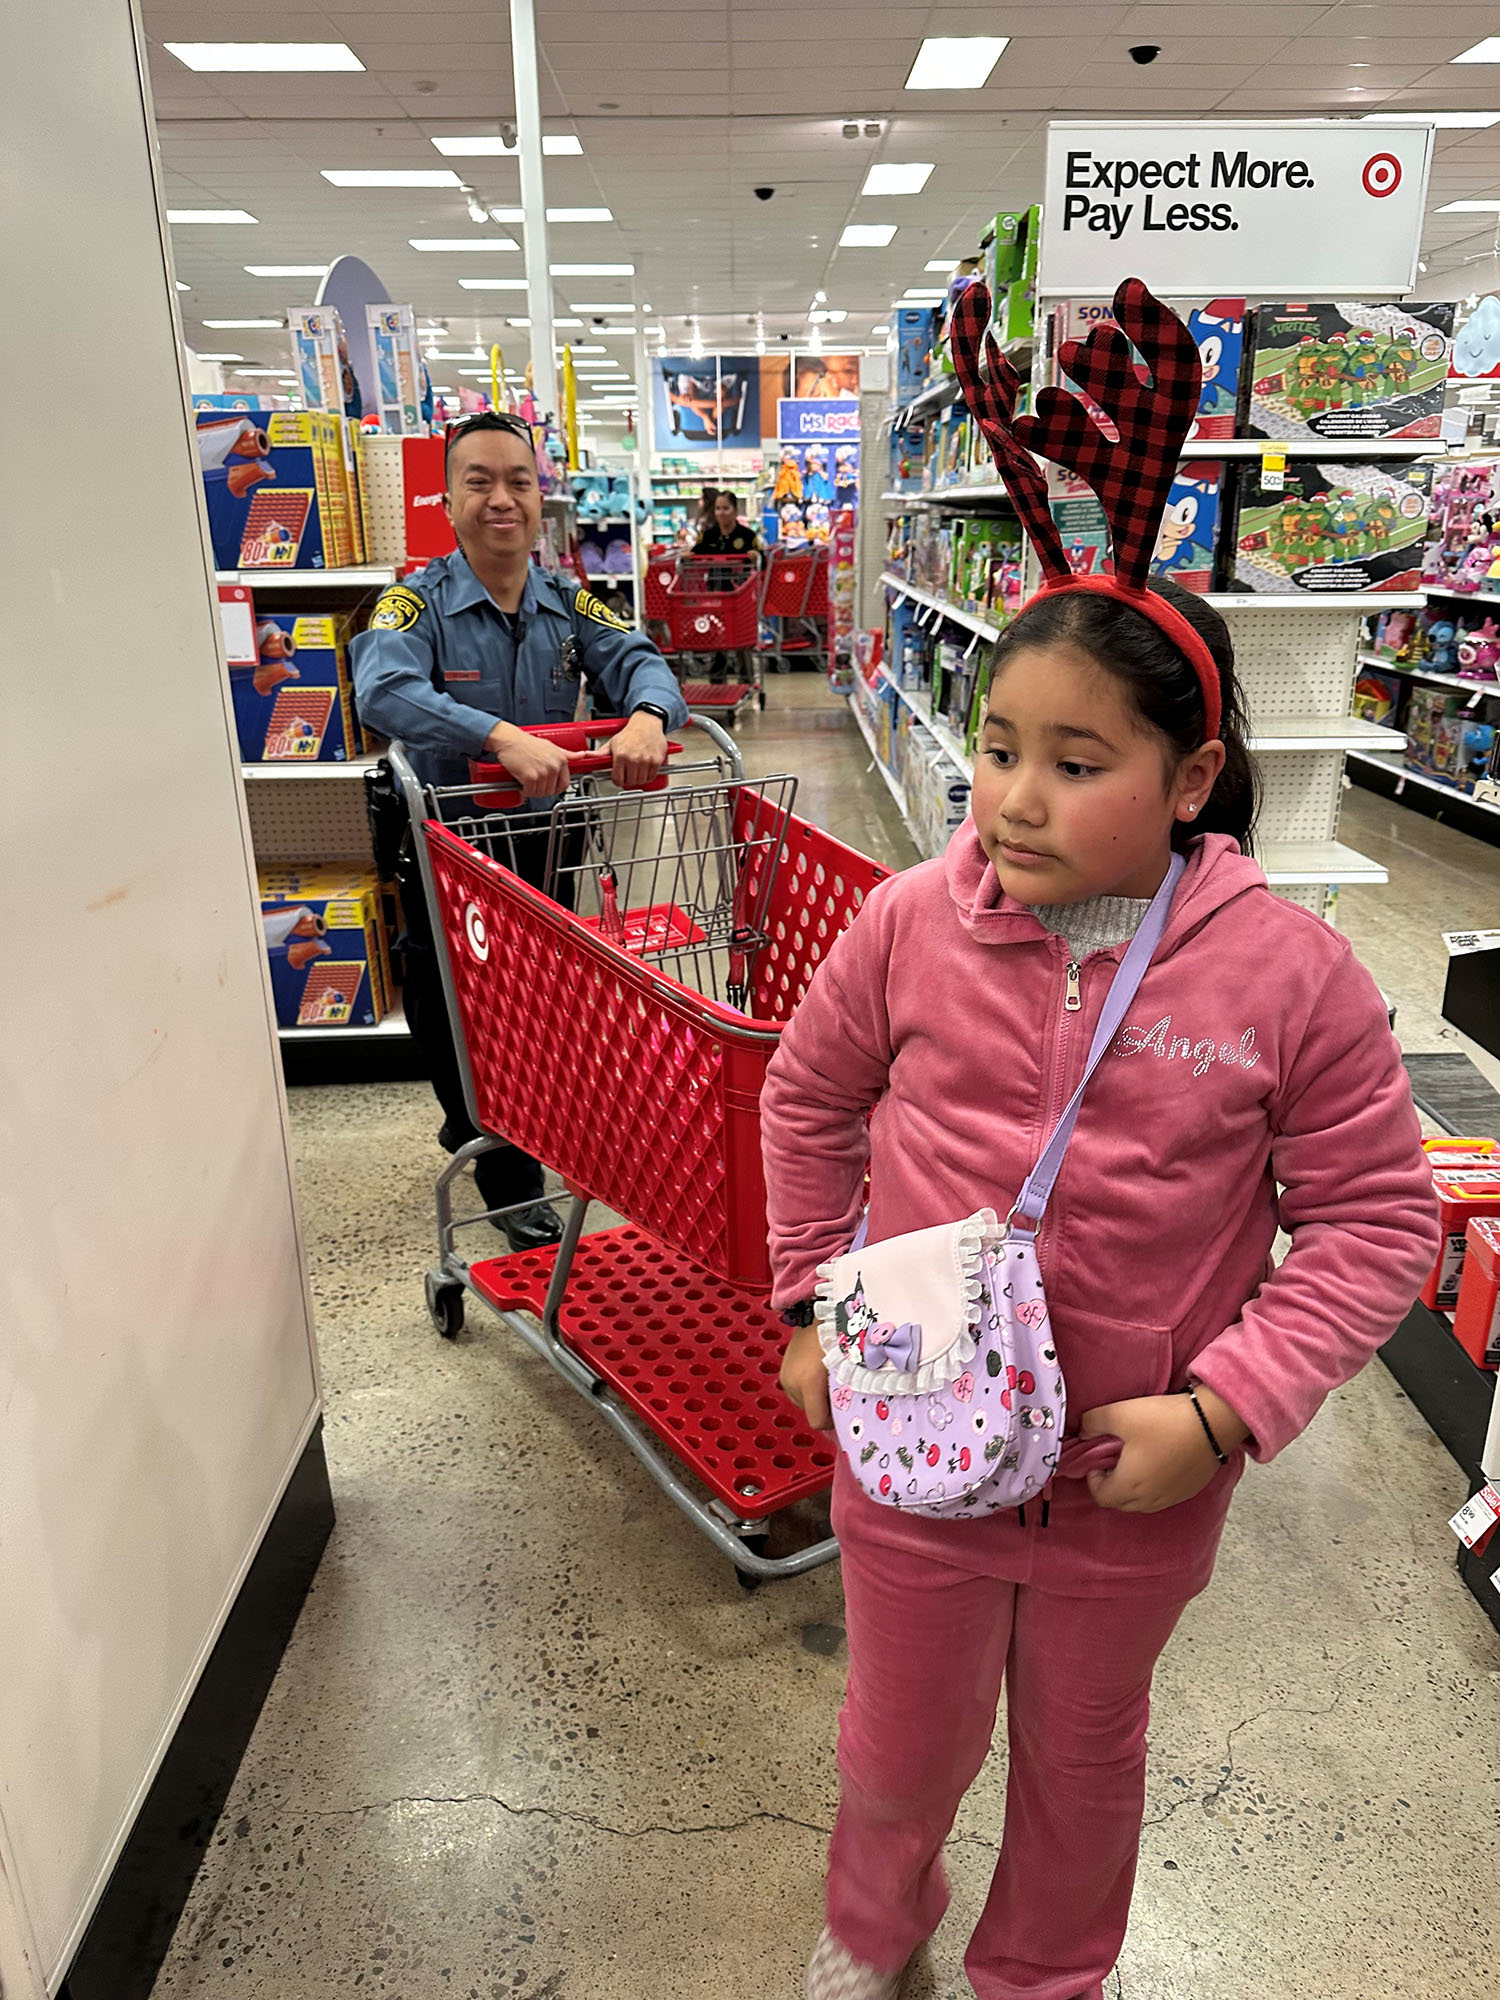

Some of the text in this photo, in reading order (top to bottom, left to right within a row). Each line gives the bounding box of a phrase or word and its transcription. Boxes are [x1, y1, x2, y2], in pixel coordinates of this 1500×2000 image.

[1066, 151, 1315, 197] Expect More.
[1063, 194, 1239, 240] Pay Less.
[1078, 306, 1114, 320] SON
[412, 492, 443, 508] Energi
[1113, 1015, 1261, 1077] Angel
